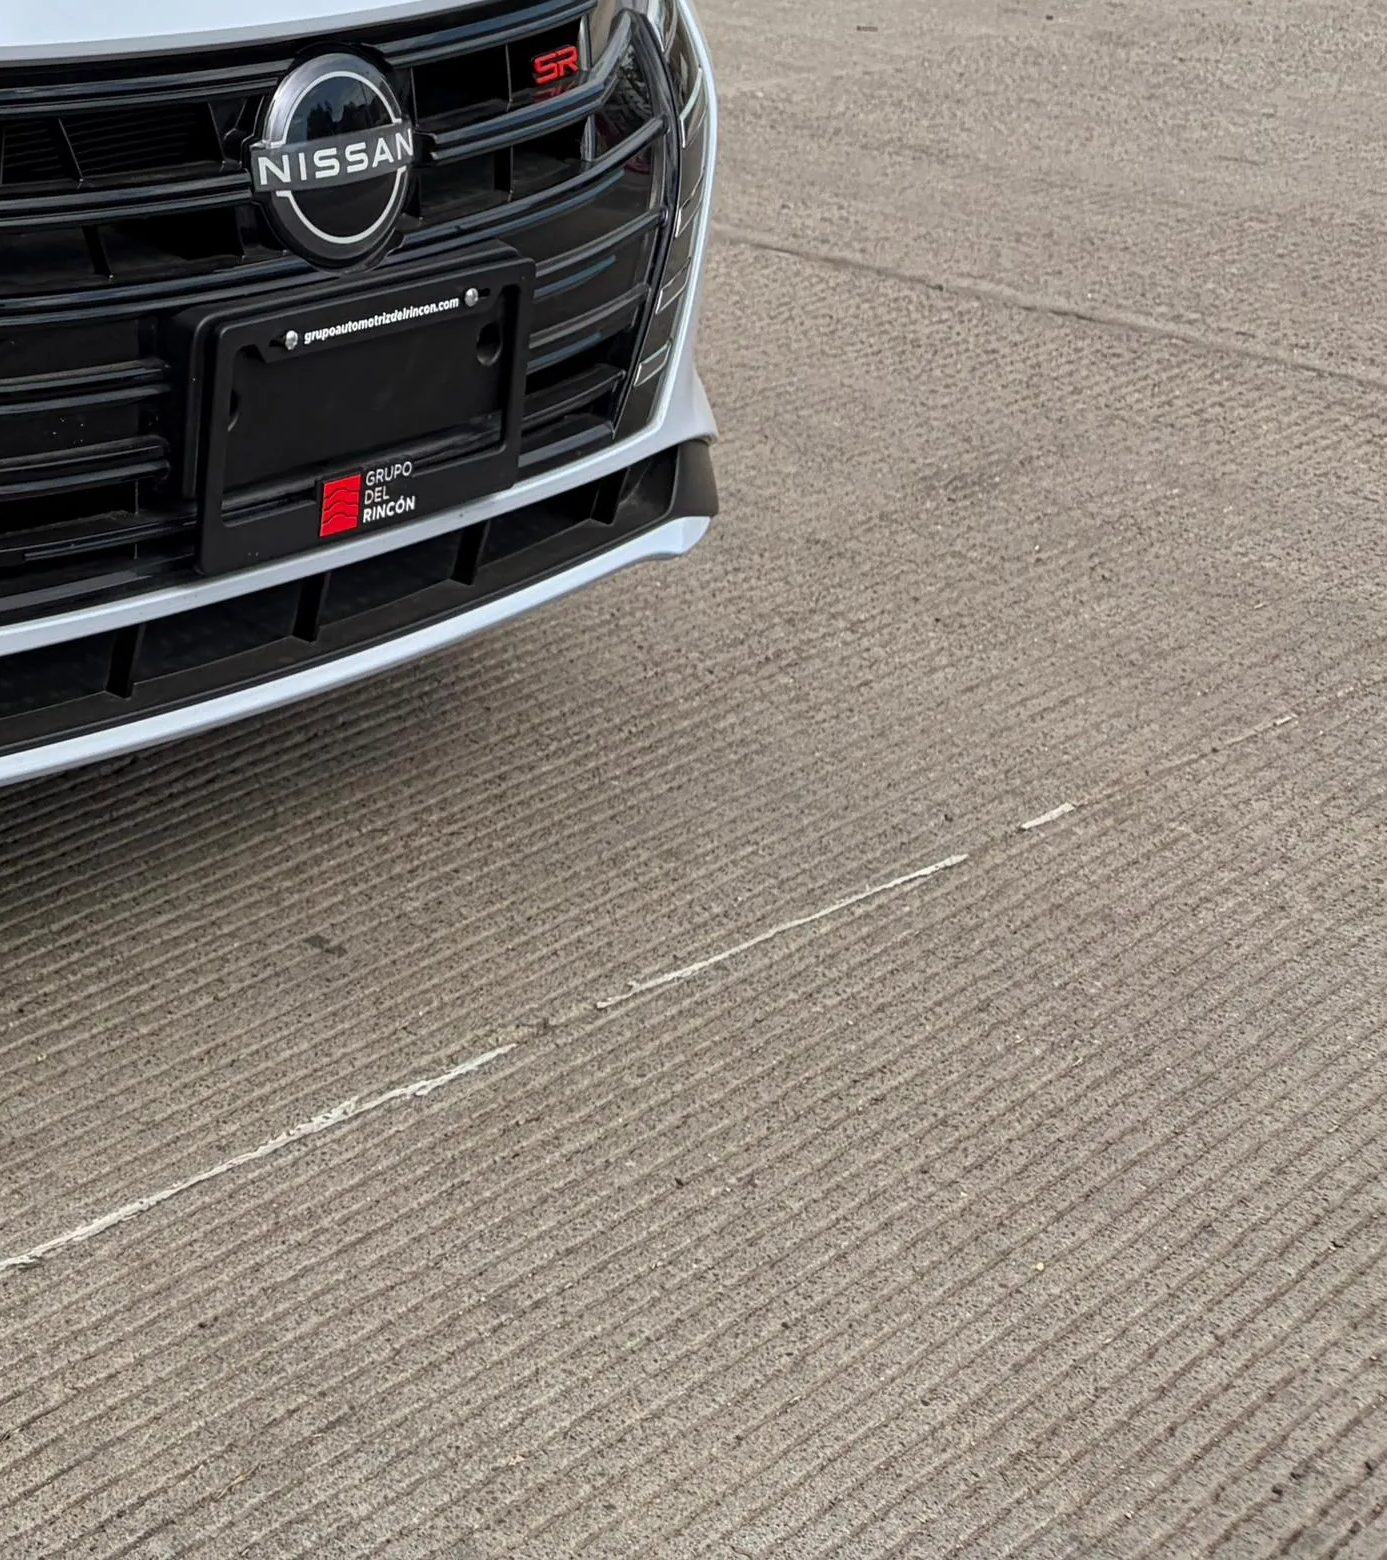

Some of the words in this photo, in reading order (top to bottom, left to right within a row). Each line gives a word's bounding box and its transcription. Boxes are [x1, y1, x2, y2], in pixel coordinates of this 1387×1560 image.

[534, 44, 579, 84] SR
[257, 128, 414, 186] NISSAN
[304, 297, 460, 344] grupoautomotrizdelrincon.com
[365, 461, 413, 486] GRUPO
[362, 496, 416, 523] RINCÓN
[364, 486, 390, 505] DEL
